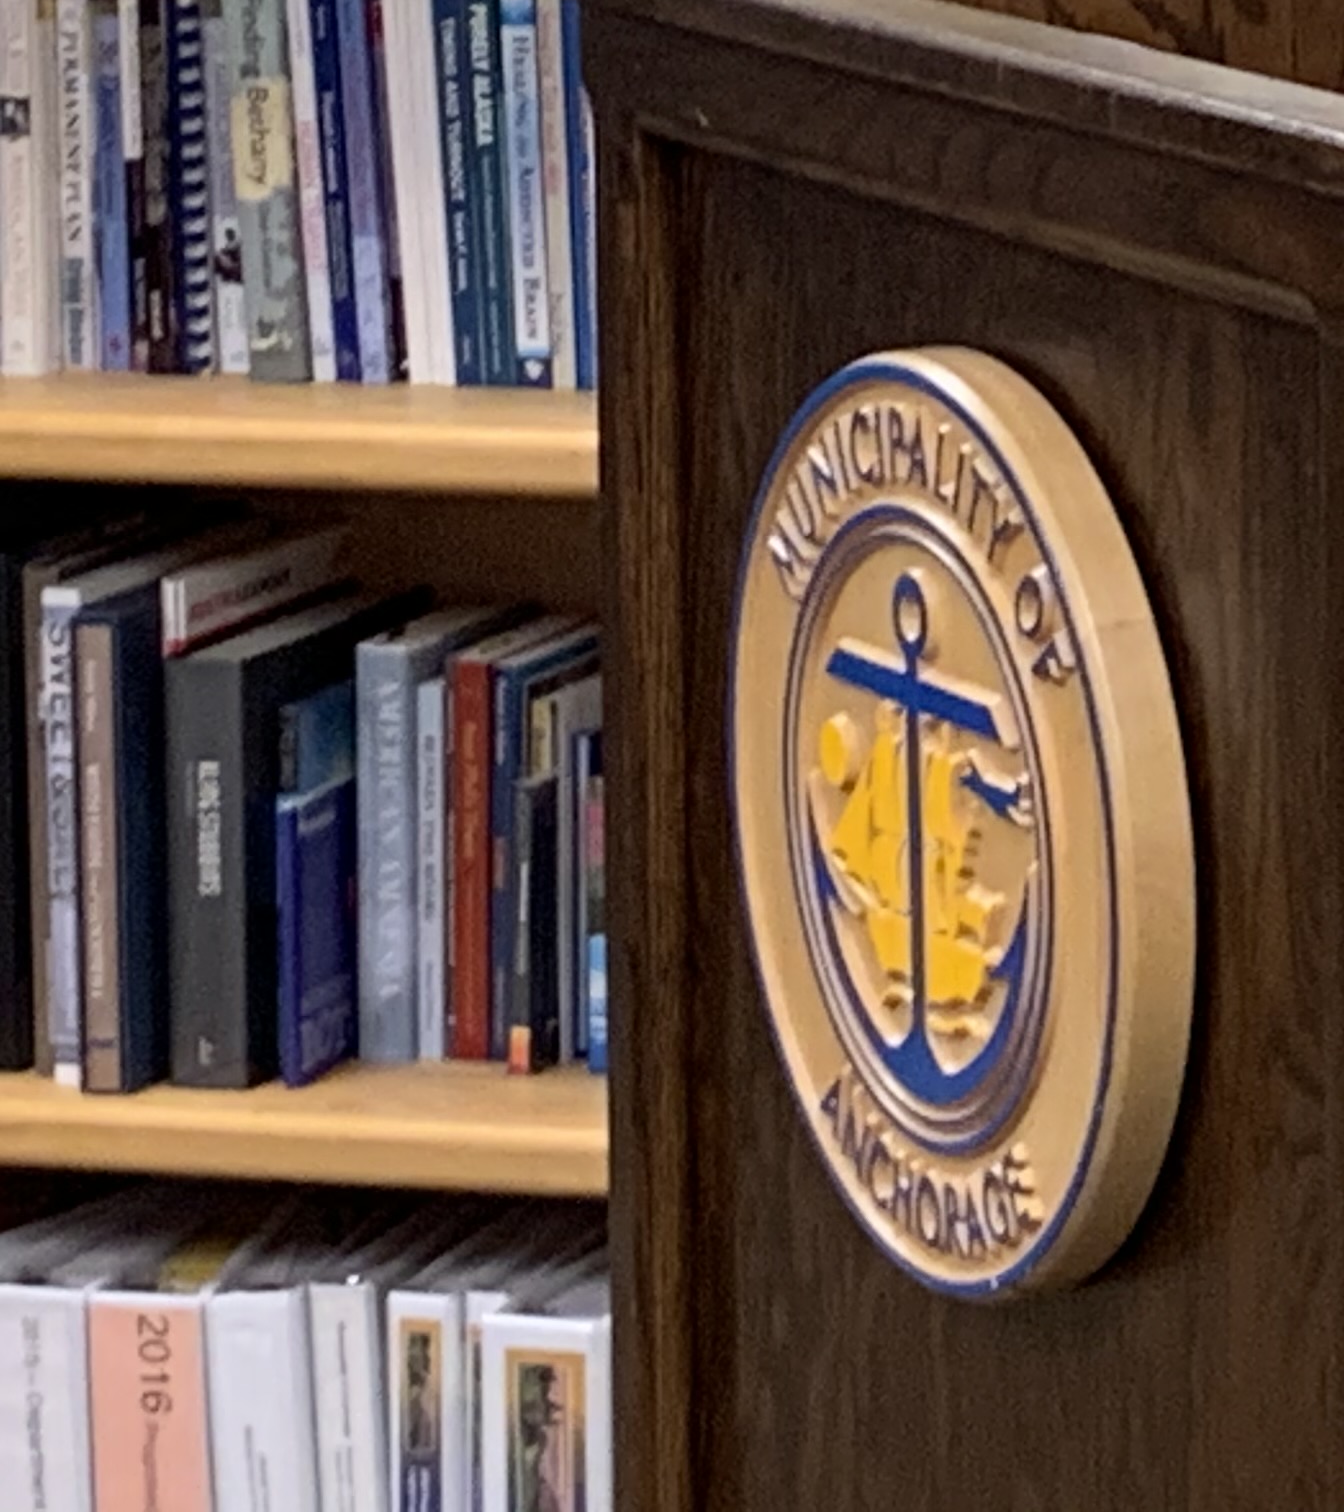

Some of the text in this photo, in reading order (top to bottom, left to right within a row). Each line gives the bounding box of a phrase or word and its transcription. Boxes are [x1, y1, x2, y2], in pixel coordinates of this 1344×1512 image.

[62, 30, 83, 175] PERMANENT
[243, 86, 272, 186] Bethany
[473, 76, 495, 148] ALASKA
[65, 181, 84, 243] PLAN
[766, 402, 1078, 686] MUNICIPALITY OF
[818, 1082, 1042, 1259] ANCHORAGE
[136, 1313, 173, 1415] 2016
